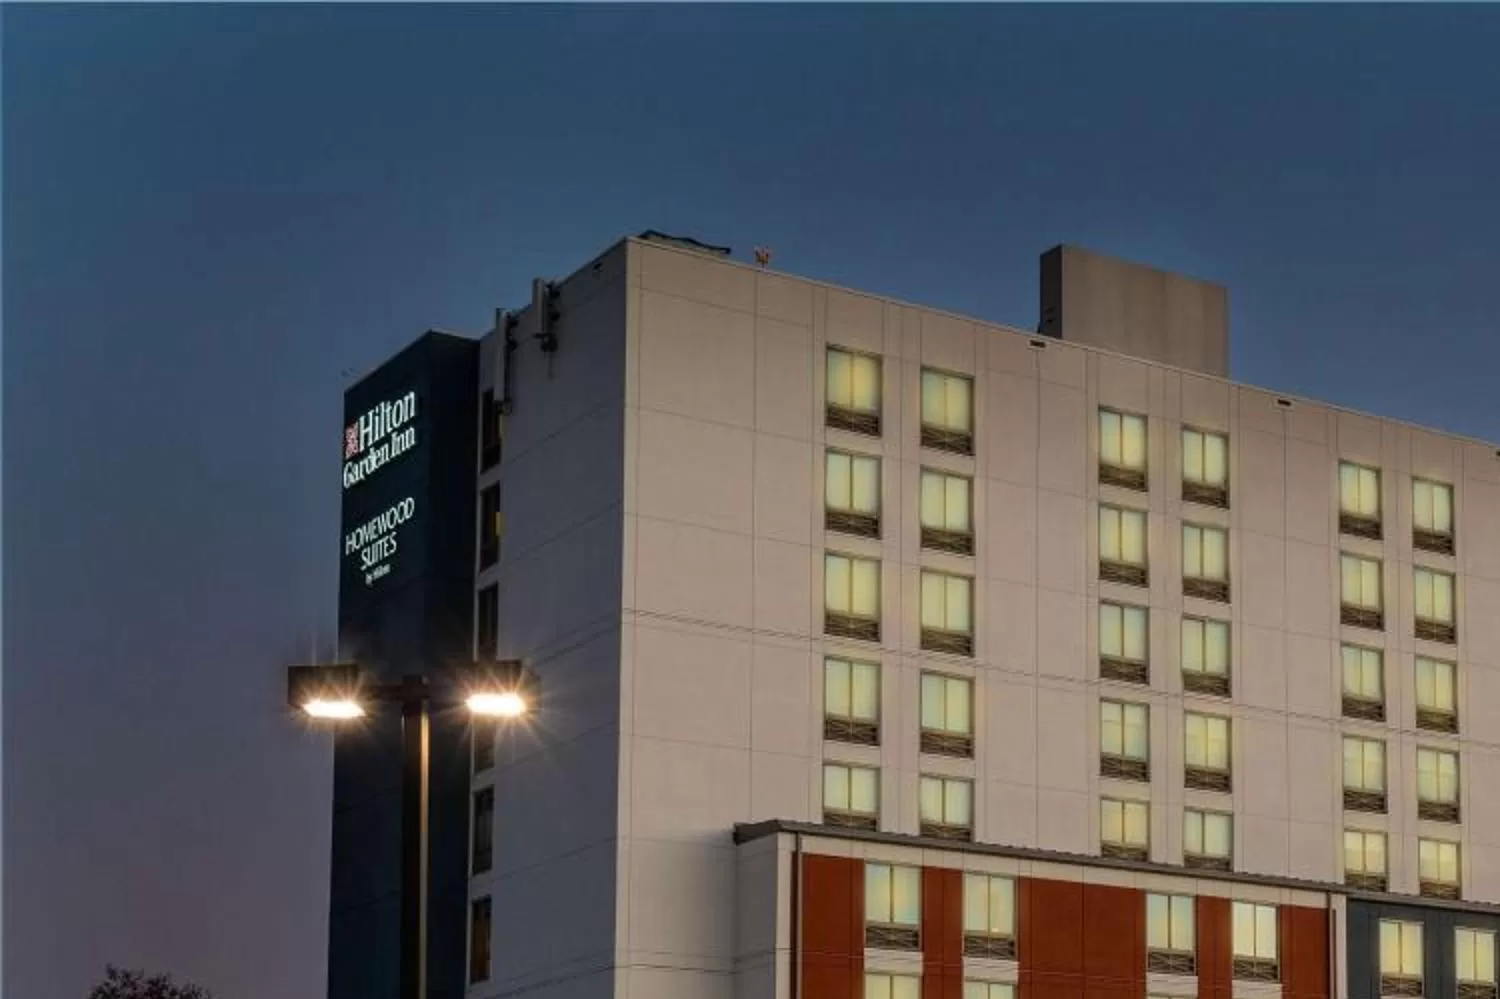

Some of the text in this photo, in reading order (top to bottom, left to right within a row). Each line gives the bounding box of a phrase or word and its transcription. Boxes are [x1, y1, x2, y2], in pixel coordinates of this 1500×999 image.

[359, 391, 415, 452] Hilton
[343, 426, 416, 489] Garden Inn
[345, 497, 415, 555] HOMEWOOD
[360, 531, 398, 571] SUITES
